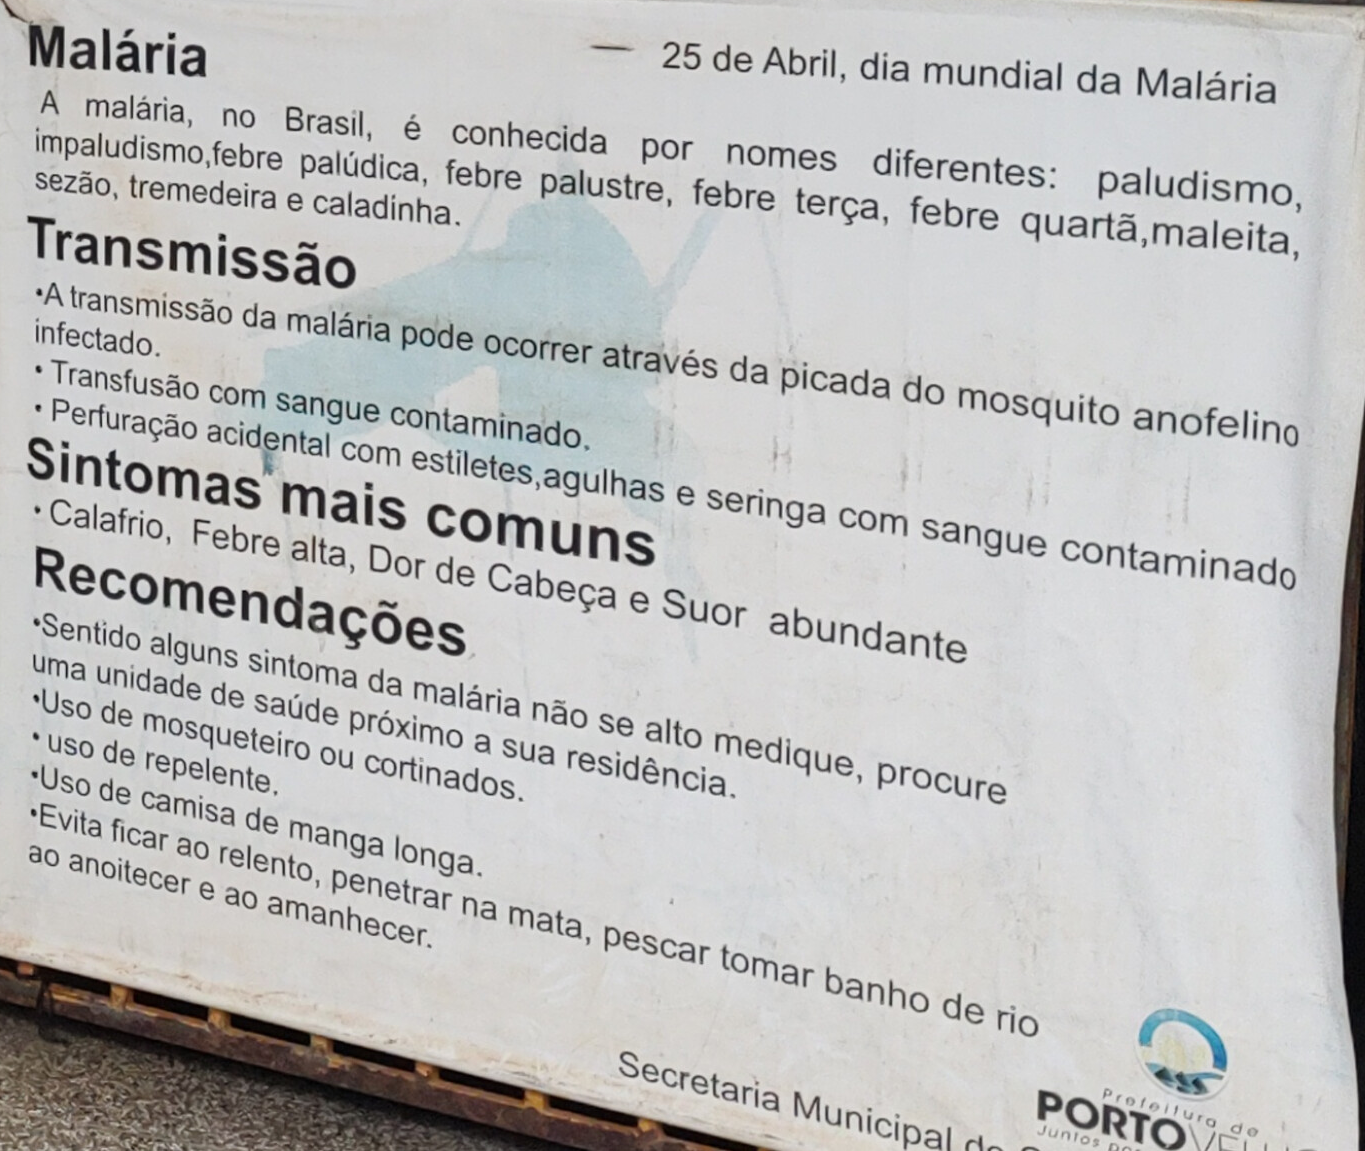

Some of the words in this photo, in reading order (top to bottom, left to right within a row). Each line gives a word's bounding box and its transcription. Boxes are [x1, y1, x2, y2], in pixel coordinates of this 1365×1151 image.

[29, 21, 206, 77] Malária
[762, 46, 845, 83] Abril,
[860, 52, 909, 82] dia
[924, 60, 1062, 91] mundial
[1137, 67, 1276, 104] Malária
[35, 171, 118, 200] sezão,
[129, 175, 276, 209] tremedeira
[313, 192, 460, 226] caladinha.
[86, 95, 192, 128] malária,
[286, 106, 371, 142] Brasil,
[452, 121, 607, 154] conhecida
[642, 138, 694, 165] por
[727, 144, 837, 171] nomes
[873, 148, 1056, 189] diferentes:
[1098, 167, 1301, 213] paludismo,
[301, 151, 427, 187] palúdica,
[445, 159, 522, 190] febre
[541, 170, 672, 207] palustre,
[693, 178, 775, 211] febre
[796, 188, 888, 226] terça,
[910, 196, 999, 230] febre
[27, 215, 356, 289] Transmissão
[36, 318, 160, 357] infectado.
[70, 286, 232, 325] transmissão
[287, 311, 390, 342] malária
[402, 324, 473, 351] pode
[484, 335, 593, 364] ocorrer
[602, 344, 718, 379] através
[781, 362, 890, 399] picada
[959, 387, 1119, 427] mosquito
[1133, 407, 1299, 447] anofelino
[51, 359, 199, 400] Transfusão
[276, 392, 380, 425] sangue
[391, 407, 590, 451] contaminado.
[27, 437, 261, 509] Sintomas
[282, 482, 406, 530] mais
[427, 504, 655, 566] comuns
[52, 398, 197, 442] Perfuração
[207, 421, 330, 458] acidental
[707, 489, 825, 528] seringa
[922, 519, 1047, 557] sangue
[1061, 540, 1296, 590] contaminado
[36, 546, 466, 656] Recomendações
[50, 499, 171, 545] Calafrio,
[193, 519, 280, 557] Febre
[291, 535, 355, 574] alta,
[370, 544, 426, 579] Dor
[488, 563, 616, 613] Cabeça
[663, 589, 747, 628] Suor
[769, 607, 967, 663] abundante
[33, 654, 85, 681] uma
[97, 666, 201, 701] unidade
[254, 694, 339, 725] saúde
[350, 710, 463, 748] próximo
[568, 750, 736, 799] residência.
[42, 613, 141, 651] Sentido
[150, 633, 238, 668] alguns
[249, 649, 357, 689] sintoma
[414, 681, 520, 718] malária
[532, 700, 588, 728] não
[645, 718, 702, 749] alto
[715, 733, 862, 784] medique,
[878, 762, 1007, 805] procure
[42, 688, 91, 720] Uso
[144, 713, 310, 760] mosqueteiro
[365, 755, 523, 802] cortinados.
[41, 764, 90, 796] Uso
[142, 791, 235, 826] camisa
[290, 820, 383, 859] manga
[395, 835, 482, 877] longa.
[146, 751, 278, 796] repelente.
[40, 803, 102, 837] Evita
[111, 818, 169, 851] ficar
[220, 845, 320, 888] relento,
[332, 869, 452, 910] penetrar
[509, 906, 590, 945] mata,
[604, 926, 711, 965] pescar
[721, 945, 814, 988] tomar
[826, 966, 929, 1013] banho
[997, 1006, 1039, 1037] rio
[69, 854, 191, 894] anoitecer
[268, 896, 432, 949] amanhecer.
[619, 1051, 779, 1112] Secretaria
[794, 1091, 951, 1151] Municipal
[1037, 1124, 1100, 1148] Juntos
[1102, 1087, 1217, 1129] Prefeitura
